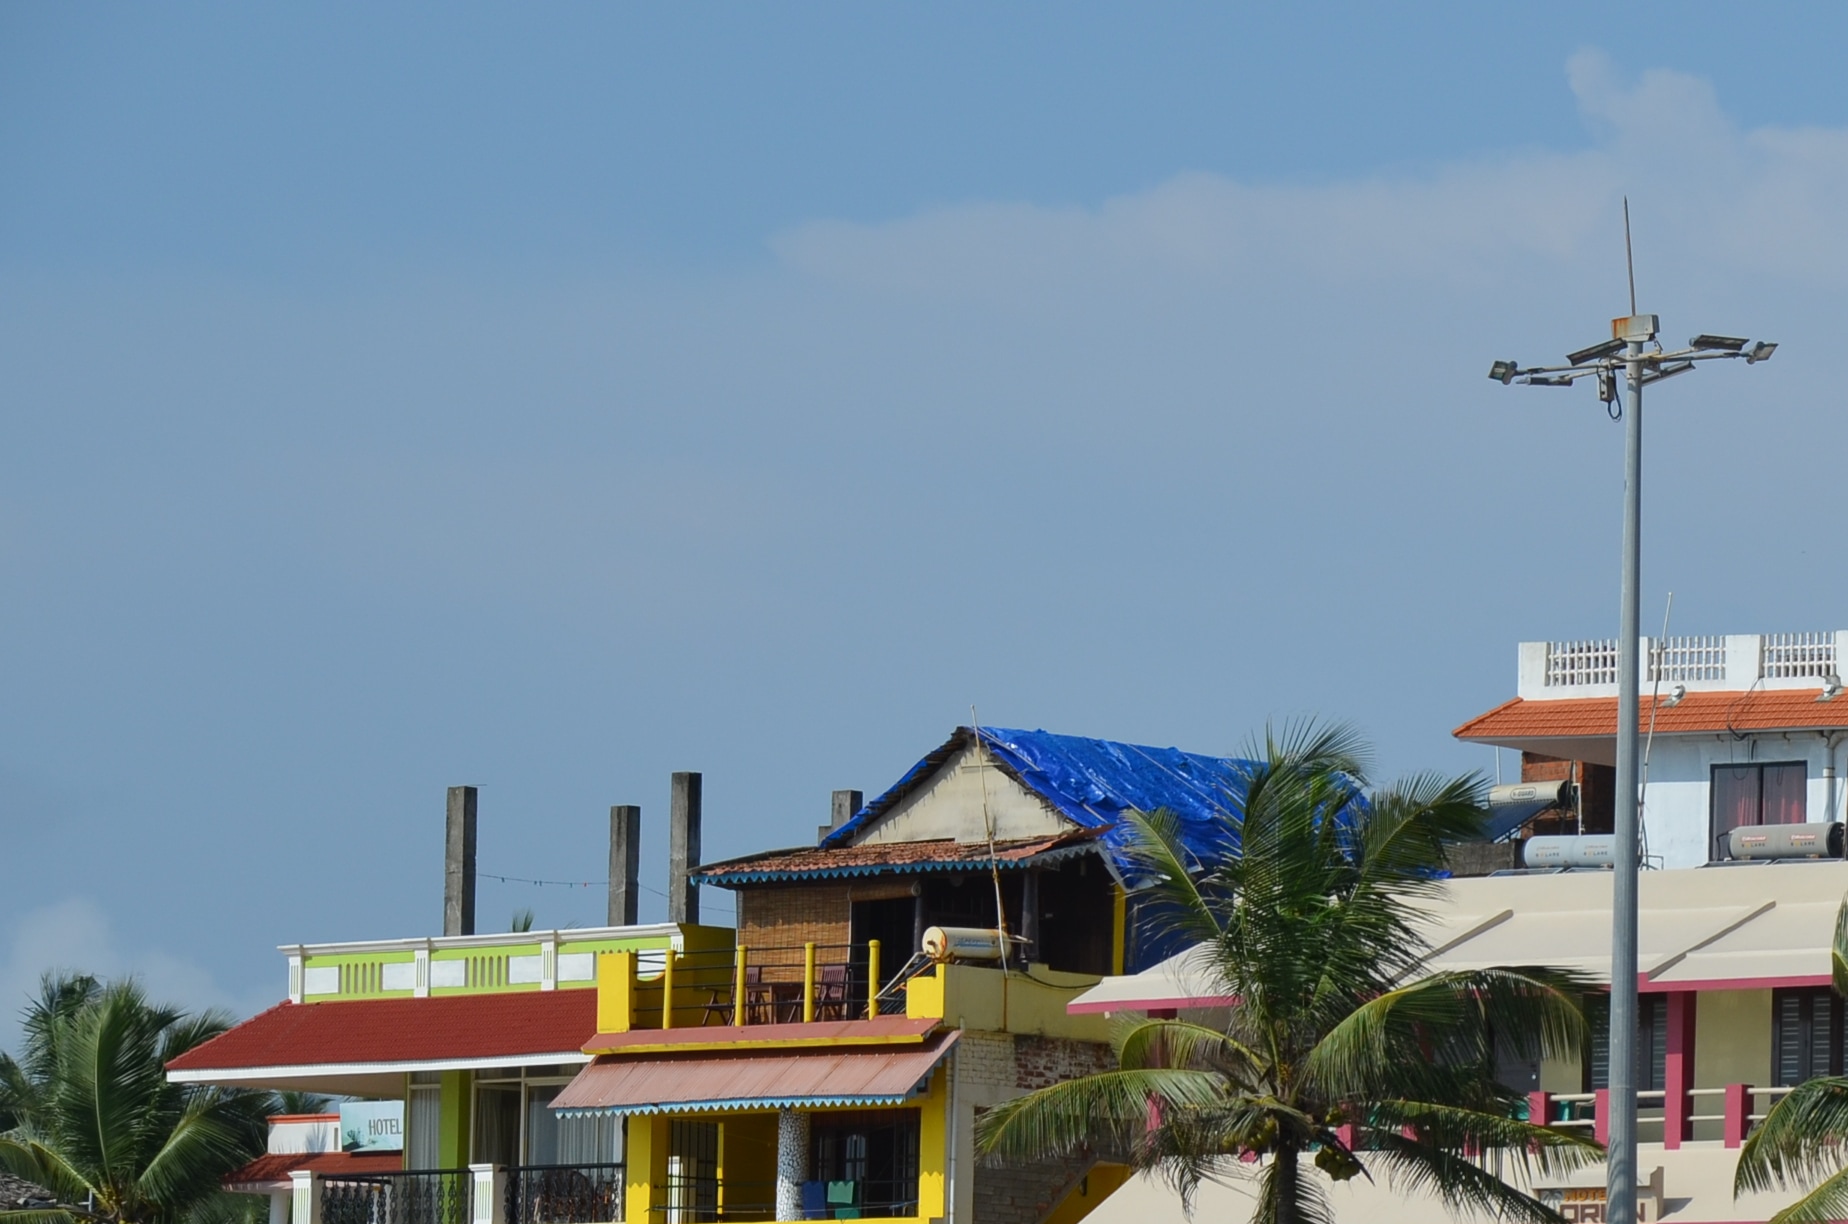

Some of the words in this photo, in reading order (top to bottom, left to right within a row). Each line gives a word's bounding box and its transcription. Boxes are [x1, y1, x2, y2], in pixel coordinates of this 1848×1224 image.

[368, 1118, 402, 1136] HOTEL
[1564, 1190, 1607, 1202] HOTE
[1559, 1203, 1646, 1223] ORIN
